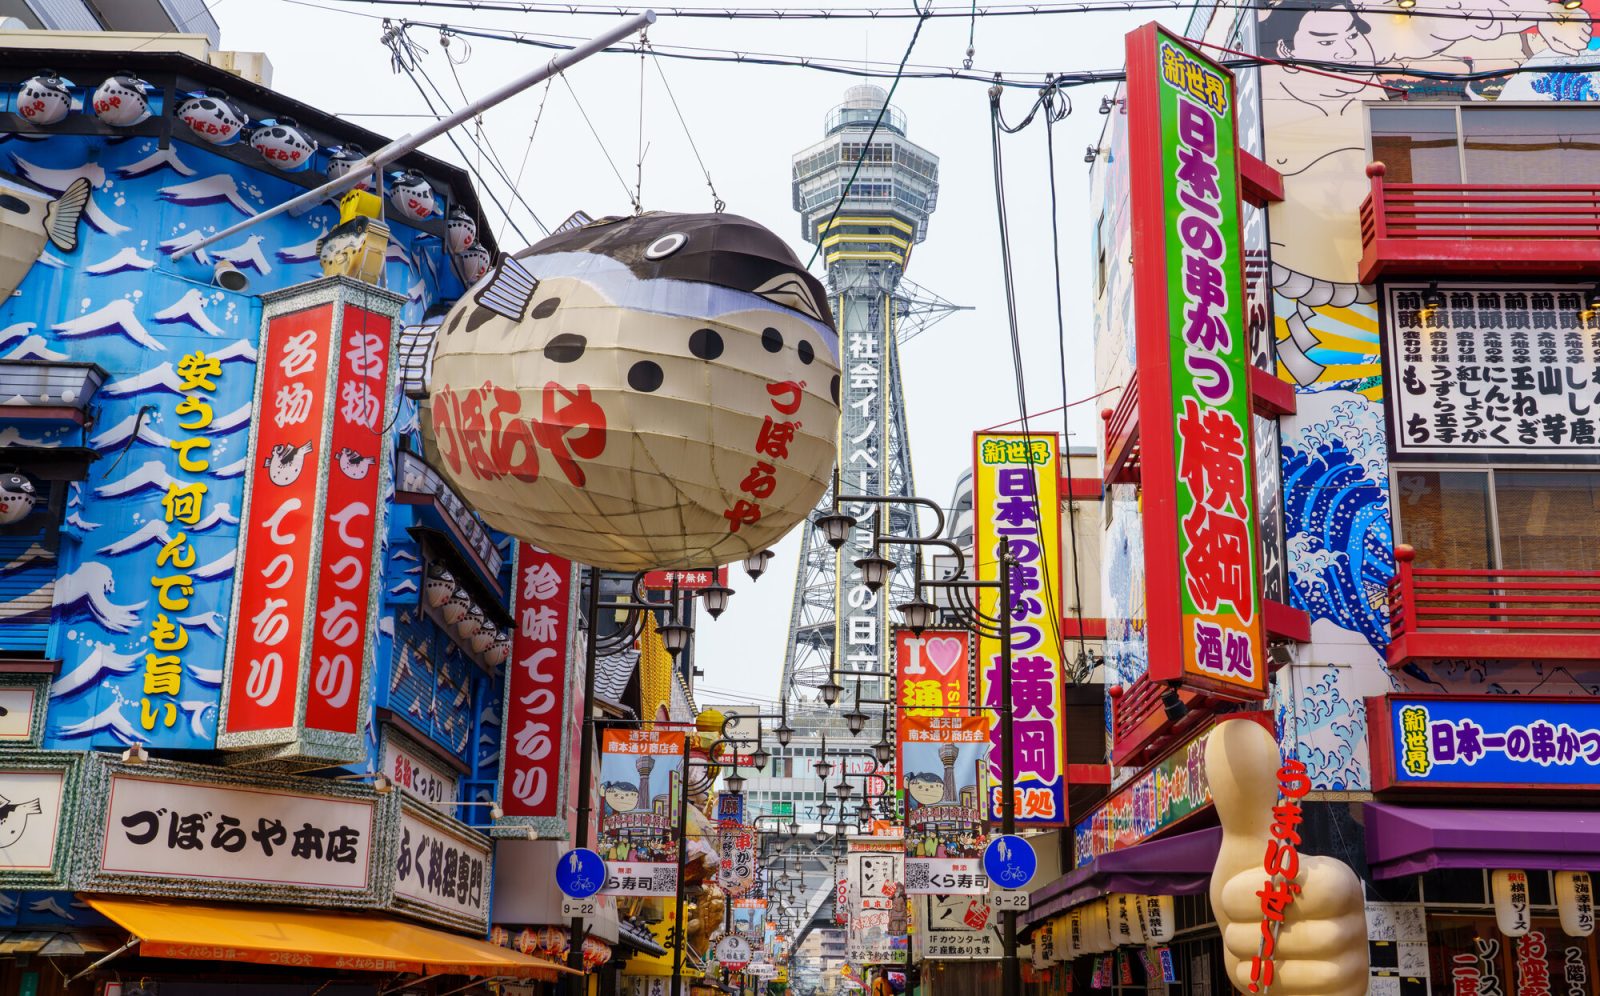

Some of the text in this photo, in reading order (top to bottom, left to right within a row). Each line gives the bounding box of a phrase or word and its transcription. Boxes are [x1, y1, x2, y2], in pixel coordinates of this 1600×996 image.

[1162, 44, 1227, 115] 新世界
[1397, 291, 1424, 329] 前頭
[1450, 292, 1477, 330] 前頭
[1476, 292, 1504, 330] 前頭
[1504, 292, 1531, 330] 前頭
[1530, 292, 1558, 330] 前頭
[1557, 292, 1585, 330] 前頭
[1177, 98, 1253, 623] 日本一の串かつ 横綱
[1402, 364, 1430, 444] もち
[1429, 364, 1460, 444] うずら玉子
[1456, 365, 1488, 444] 紅しょうが
[1482, 365, 1512, 444] にんにく
[1510, 365, 1541, 445] 玉ねぎ
[1537, 365, 1568, 445] 山芋
[1565, 366, 1596, 445] しし唐
[432, 379, 608, 488] づぼらや
[723, 379, 807, 533] づぼらや
[983, 439, 1051, 465] 新世界
[139, 350, 223, 731] 安うて何んでも旨い
[245, 329, 318, 708] 名物 てっちり
[314, 329, 383, 709] 名物 てっちり
[664, 572, 708, 584] 年中無休
[511, 541, 563, 807] 珍味てっちり
[904, 637, 926, 675] I
[1195, 622, 1253, 680] 酒処
[908, 729, 984, 741] 南本通り商店会
[929, 717, 962, 729] 通天閣
[986, 655, 1056, 783] 横綱
[1402, 708, 1600, 775] 新世界 日本一の串かつ
[608, 741, 679, 753] 南本通り商店会
[994, 788, 1054, 817] 酒処
[121, 807, 361, 864] づぼらや本店
[735, 832, 752, 877] 串かつ
[396, 826, 484, 909] ふぐ料理専門
[608, 876, 653, 891] ら寿司
[929, 873, 989, 889] くら寿司
[563, 903, 594, 914] 9-22
[995, 895, 1027, 906] 9-22
[940, 935, 991, 943] カウンター席
[940, 946, 990, 954] 座敷あります
